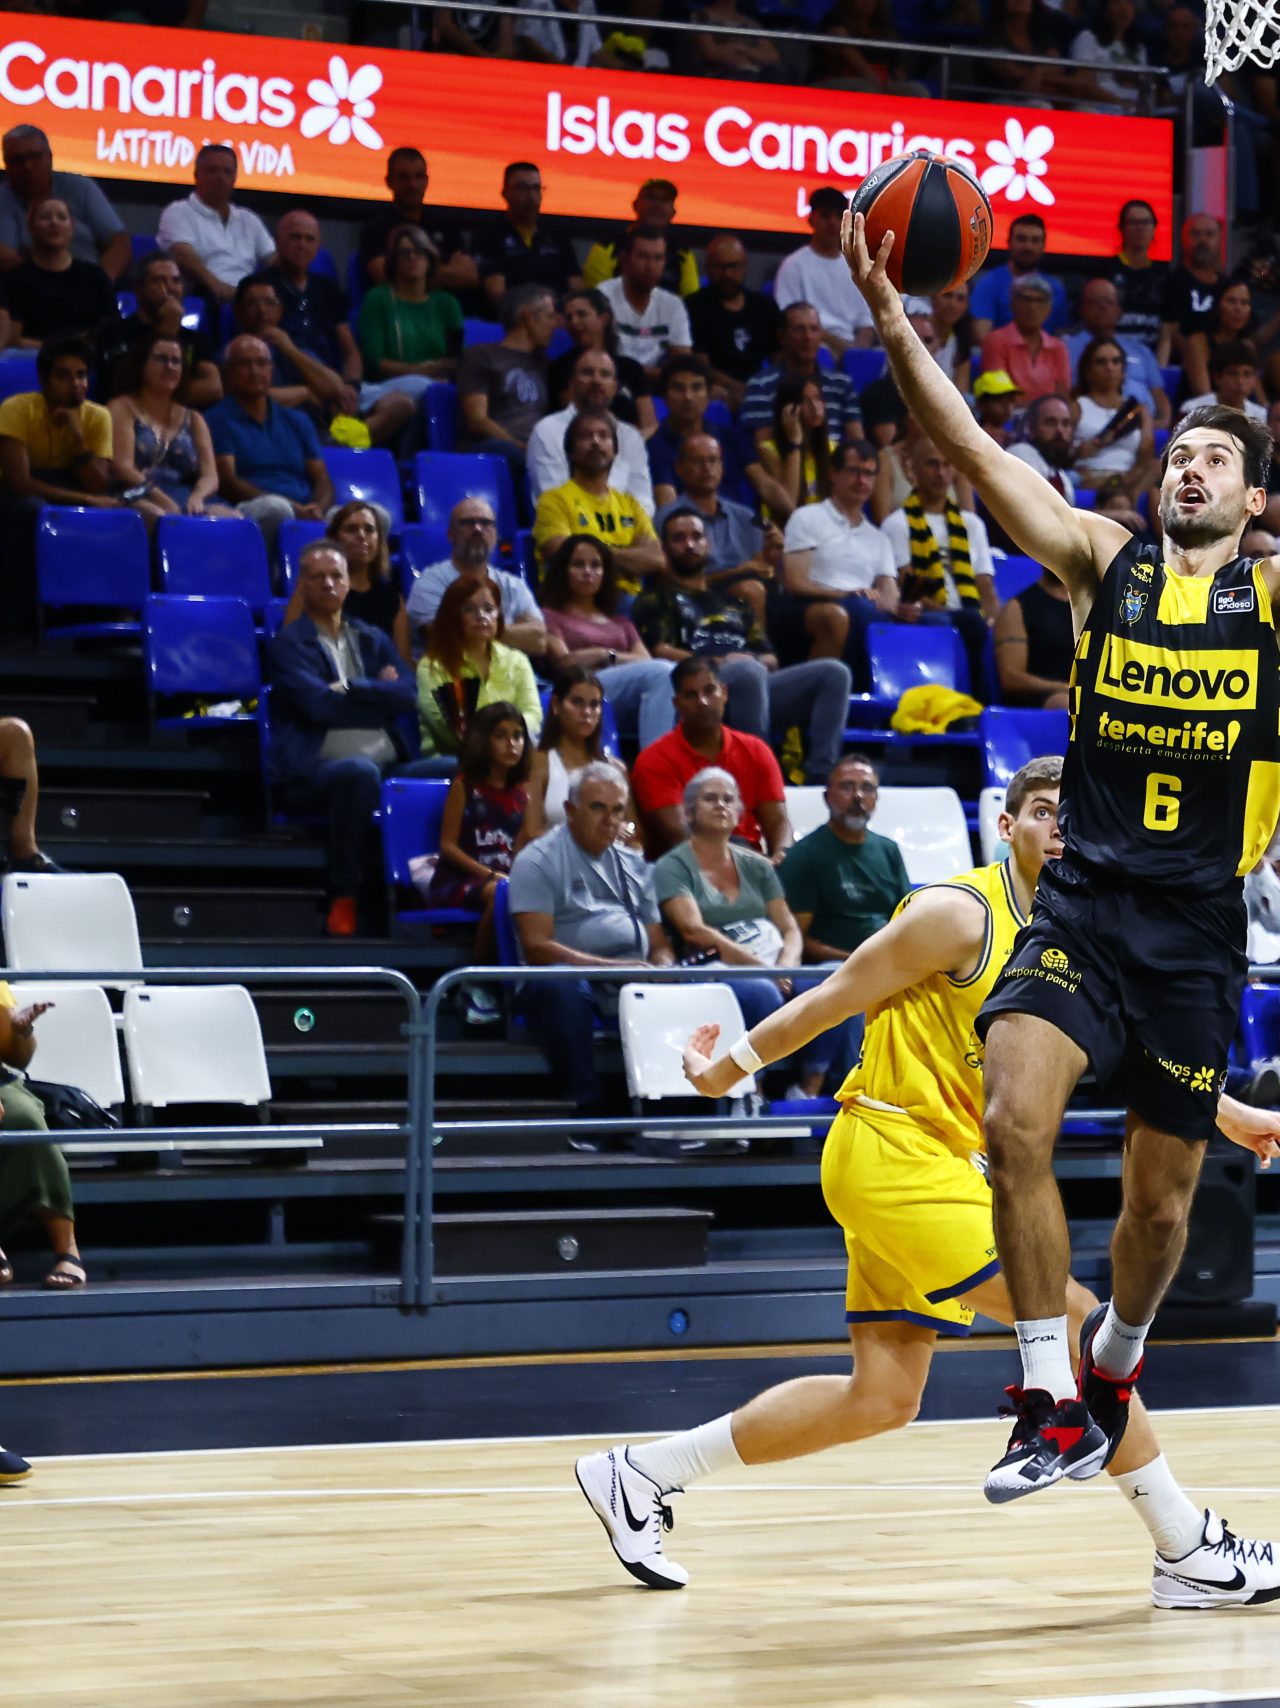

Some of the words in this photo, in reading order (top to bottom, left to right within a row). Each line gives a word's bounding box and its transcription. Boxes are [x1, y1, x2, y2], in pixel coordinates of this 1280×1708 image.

[0, 41, 296, 128] Canarias
[96, 127, 196, 169] LATITUD
[547, 91, 691, 163] Islas
[239, 140, 296, 177] VIDA
[1218, 600, 1251, 610] endesa
[1103, 645, 1250, 700] Lenovo
[1097, 738, 1151, 755] despierta
[1143, 772, 1182, 832] 6
[1045, 972, 1068, 989] para
